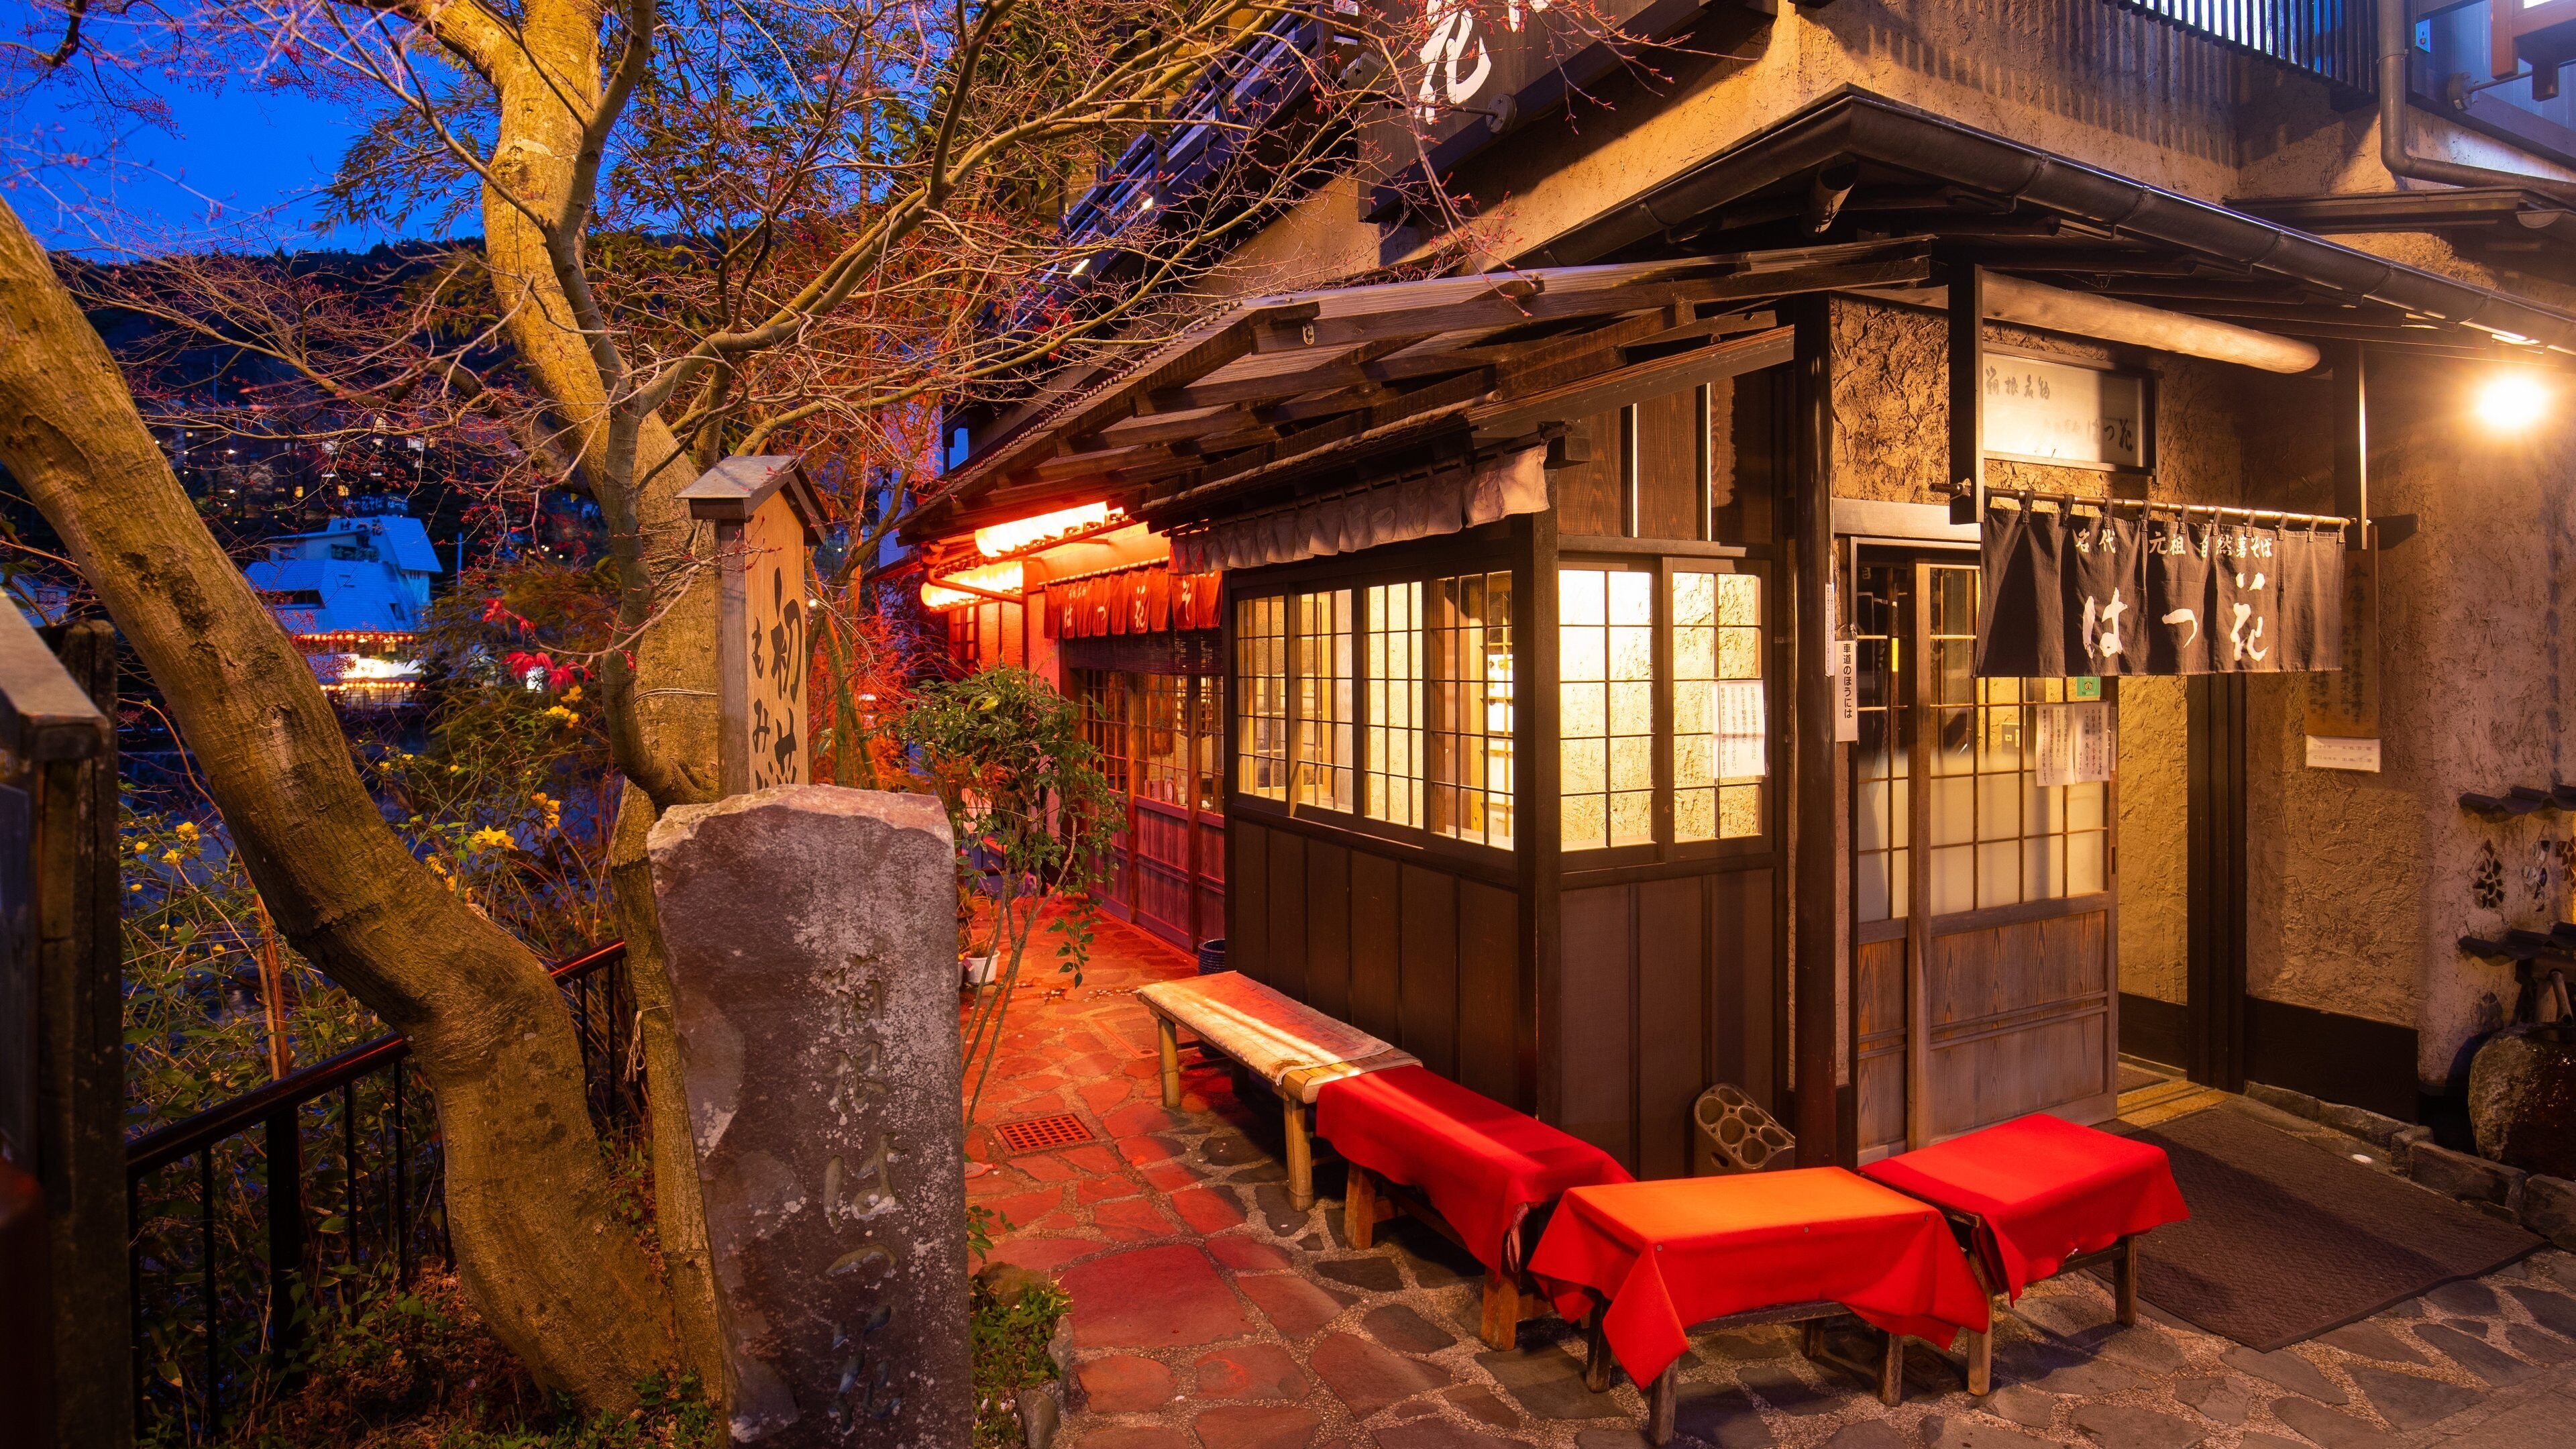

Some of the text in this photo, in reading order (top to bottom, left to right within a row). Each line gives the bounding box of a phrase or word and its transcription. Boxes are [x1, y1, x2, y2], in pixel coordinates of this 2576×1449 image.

[2082, 572, 2269, 662] はつ花
[1843, 643, 1852, 719] 車道のほうには
